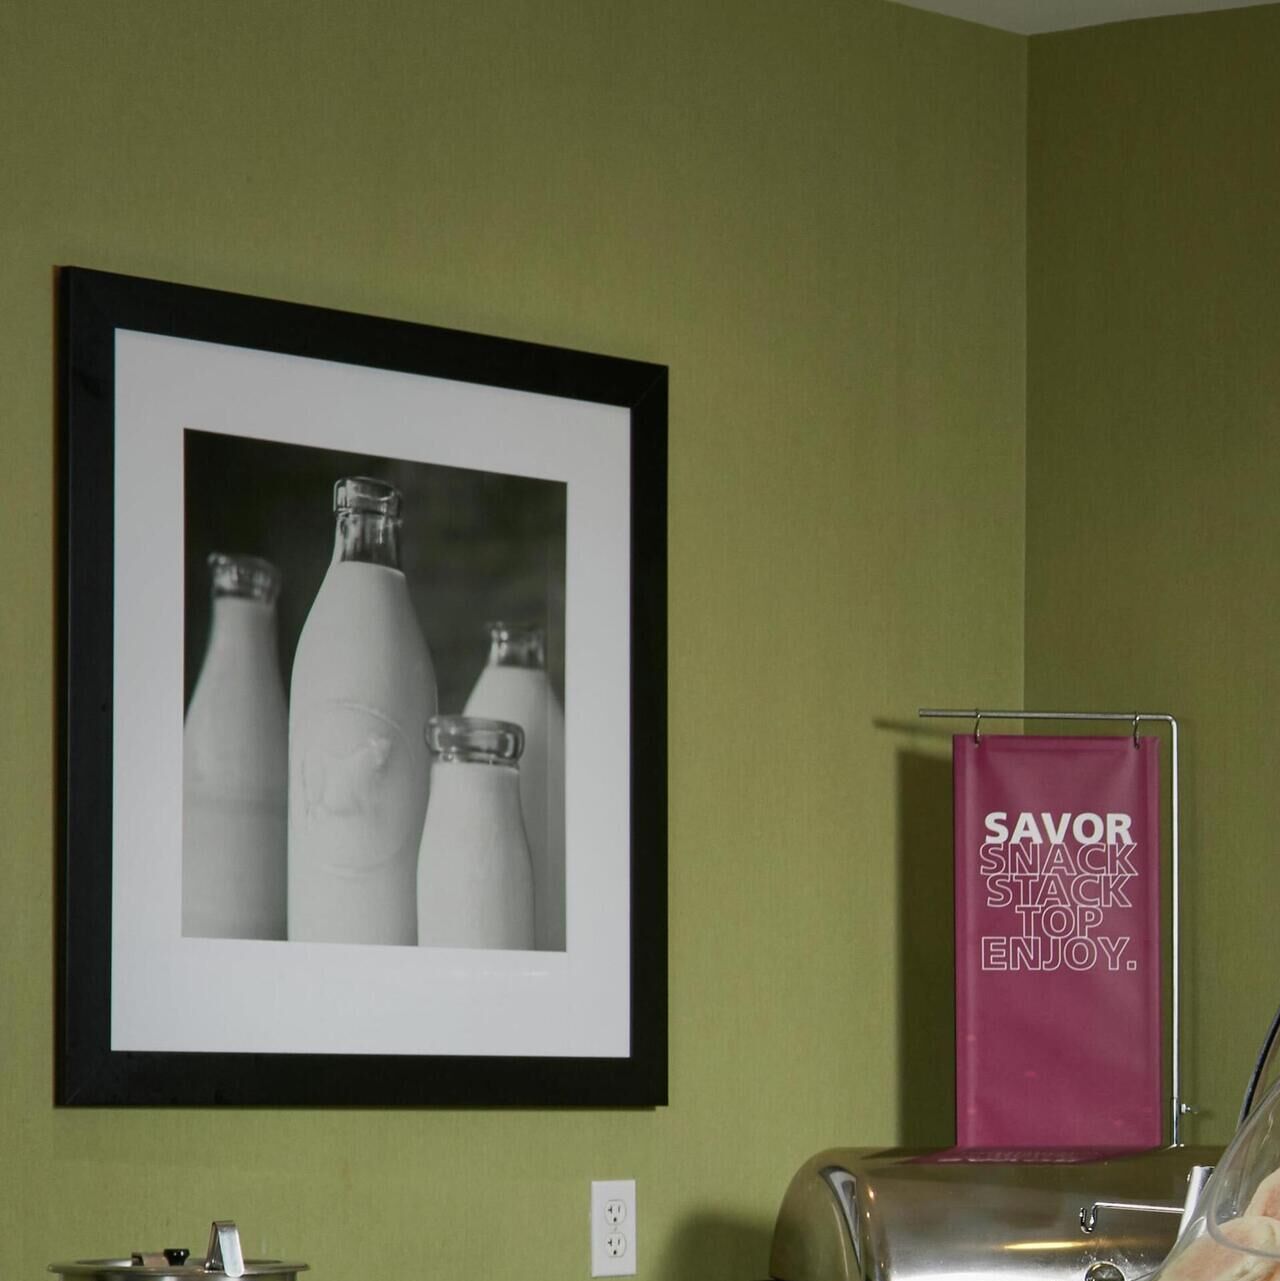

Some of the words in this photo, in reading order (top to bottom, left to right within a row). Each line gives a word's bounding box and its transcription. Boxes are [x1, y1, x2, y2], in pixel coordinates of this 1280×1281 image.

[984, 812, 1133, 845] SAVOR
[980, 842, 1138, 876] SNACK
[986, 873, 1132, 908] STACK
[1015, 905, 1103, 939] TOP
[982, 937, 1137, 971] ENJOY.
